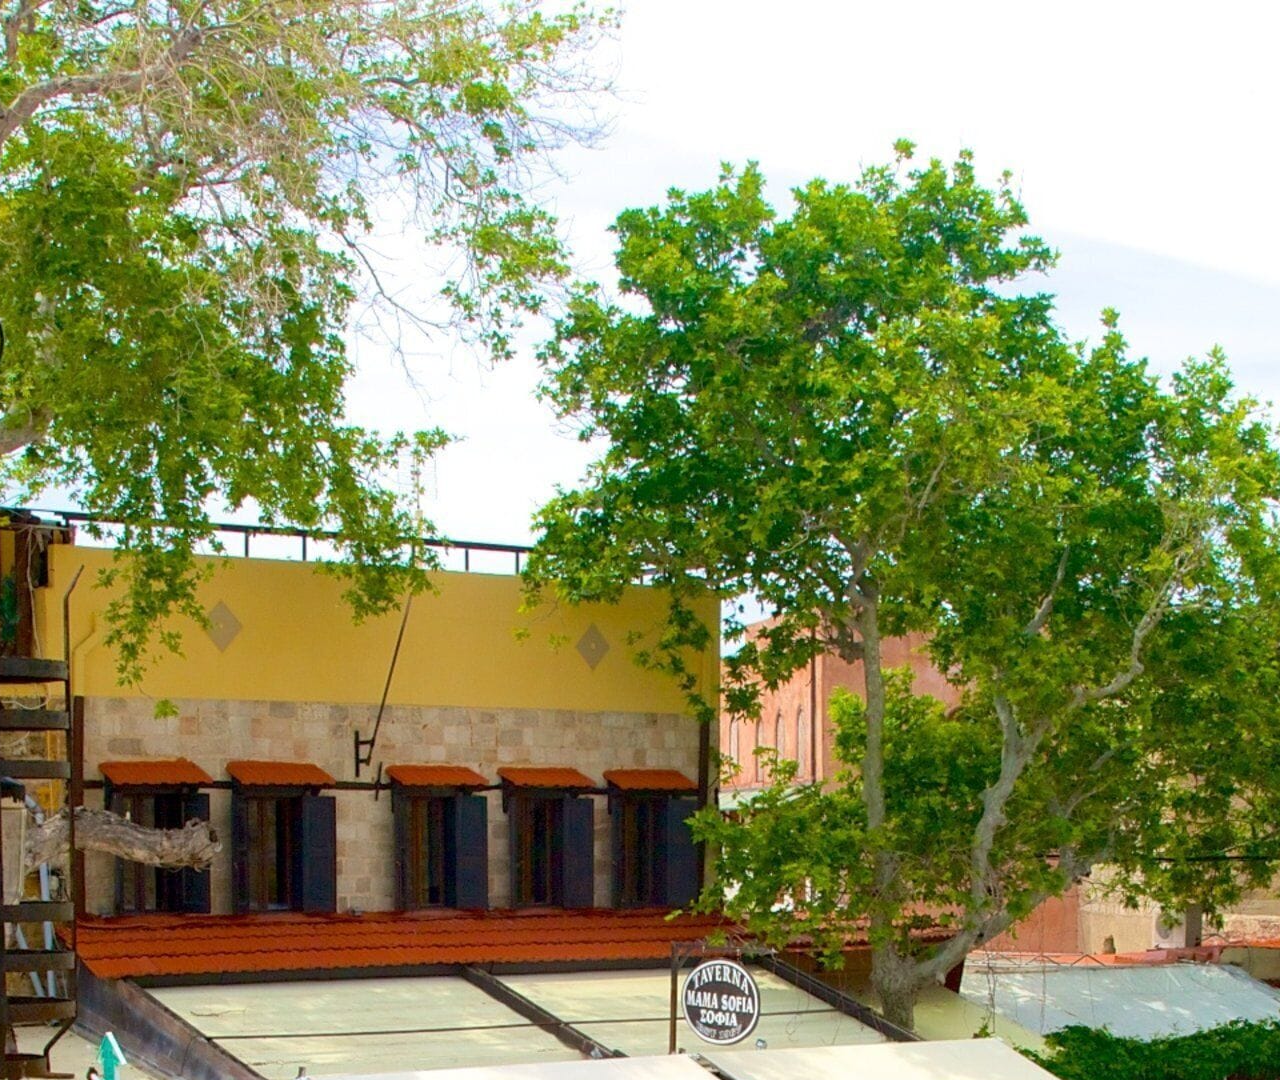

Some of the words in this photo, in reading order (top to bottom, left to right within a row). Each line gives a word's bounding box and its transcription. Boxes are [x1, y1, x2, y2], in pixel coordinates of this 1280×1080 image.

[693, 965, 749, 995] TAVERNA
[687, 990, 718, 1009] MAMA
[721, 994, 753, 1013] SOFIA
[700, 1009, 737, 1026] ΣΟΦΙΑ
